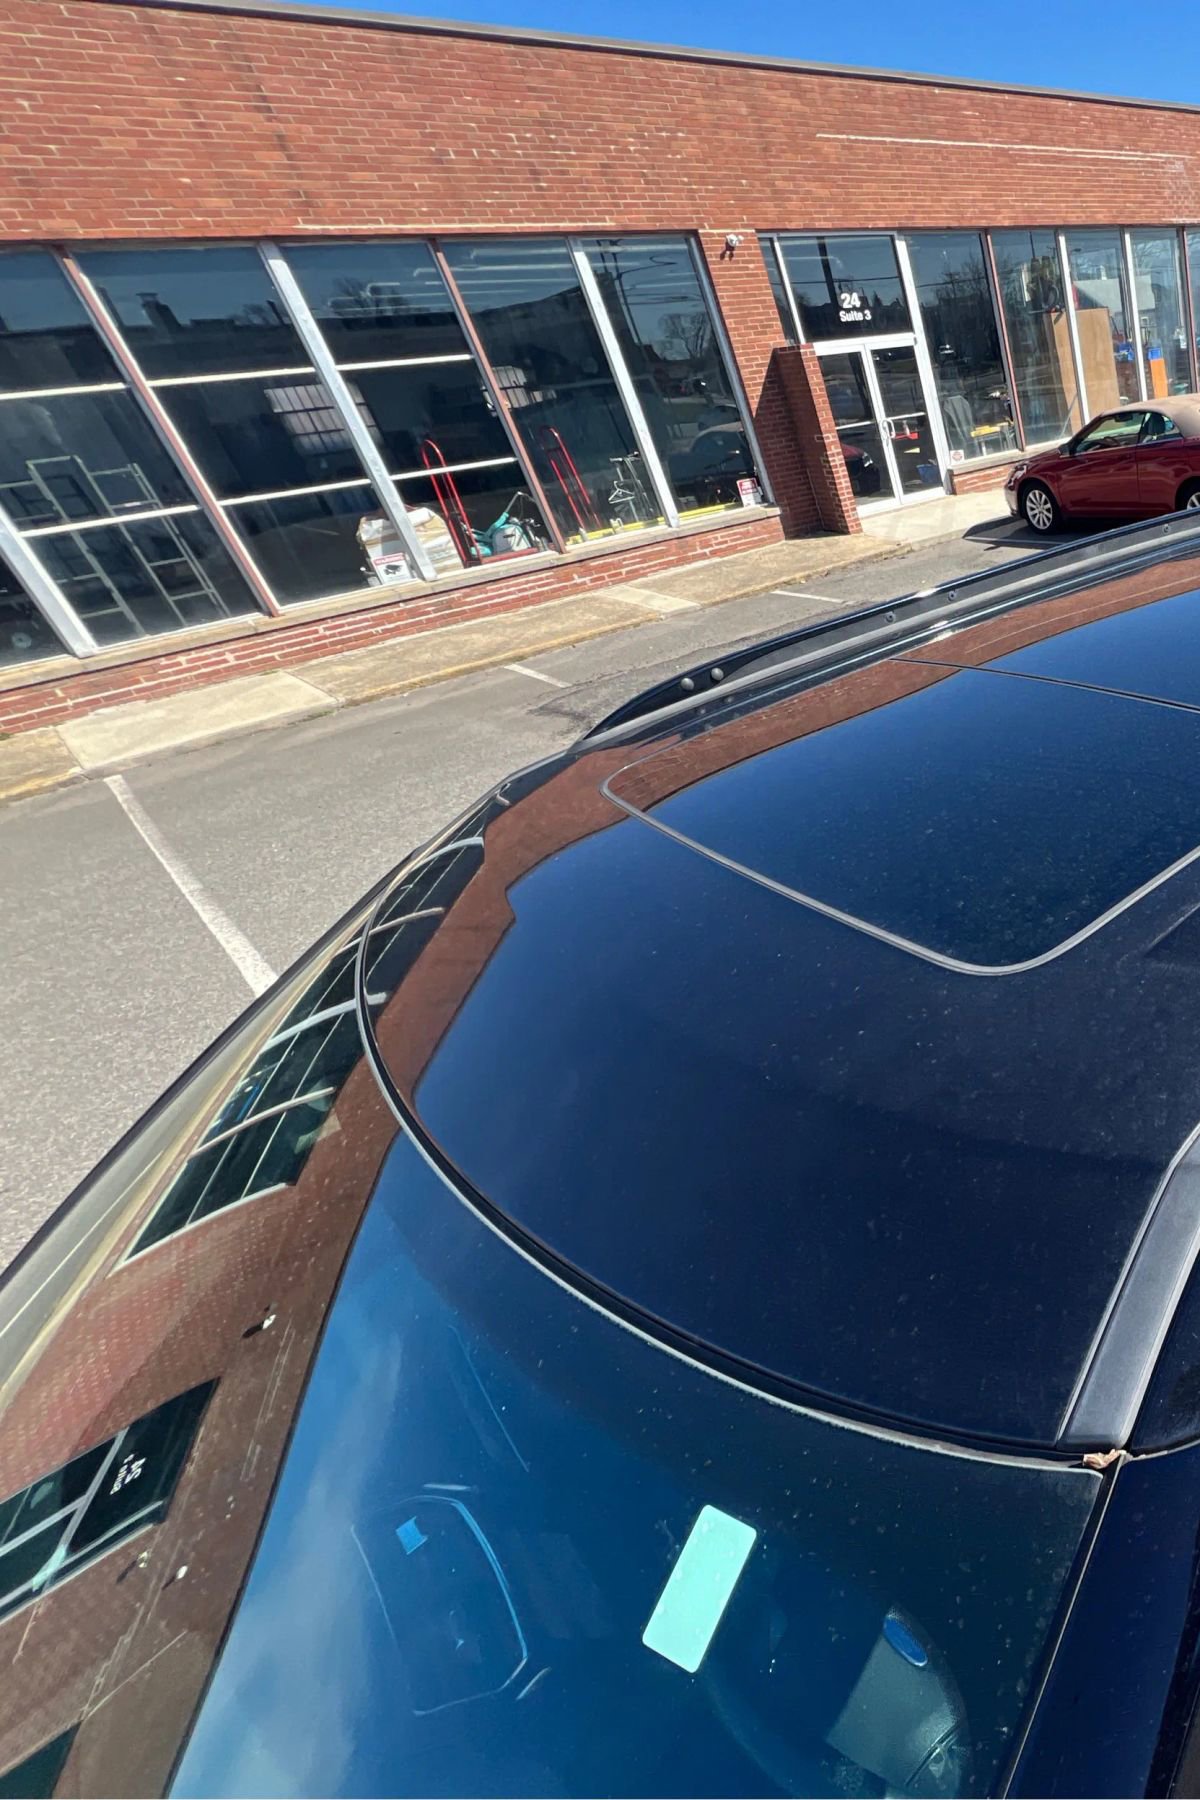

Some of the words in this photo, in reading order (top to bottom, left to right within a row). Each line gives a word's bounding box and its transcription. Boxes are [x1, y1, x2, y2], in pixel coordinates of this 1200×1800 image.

[840, 292, 861, 309] 24
[839, 310, 863, 322] Suite
[864, 309, 872, 321] 3
